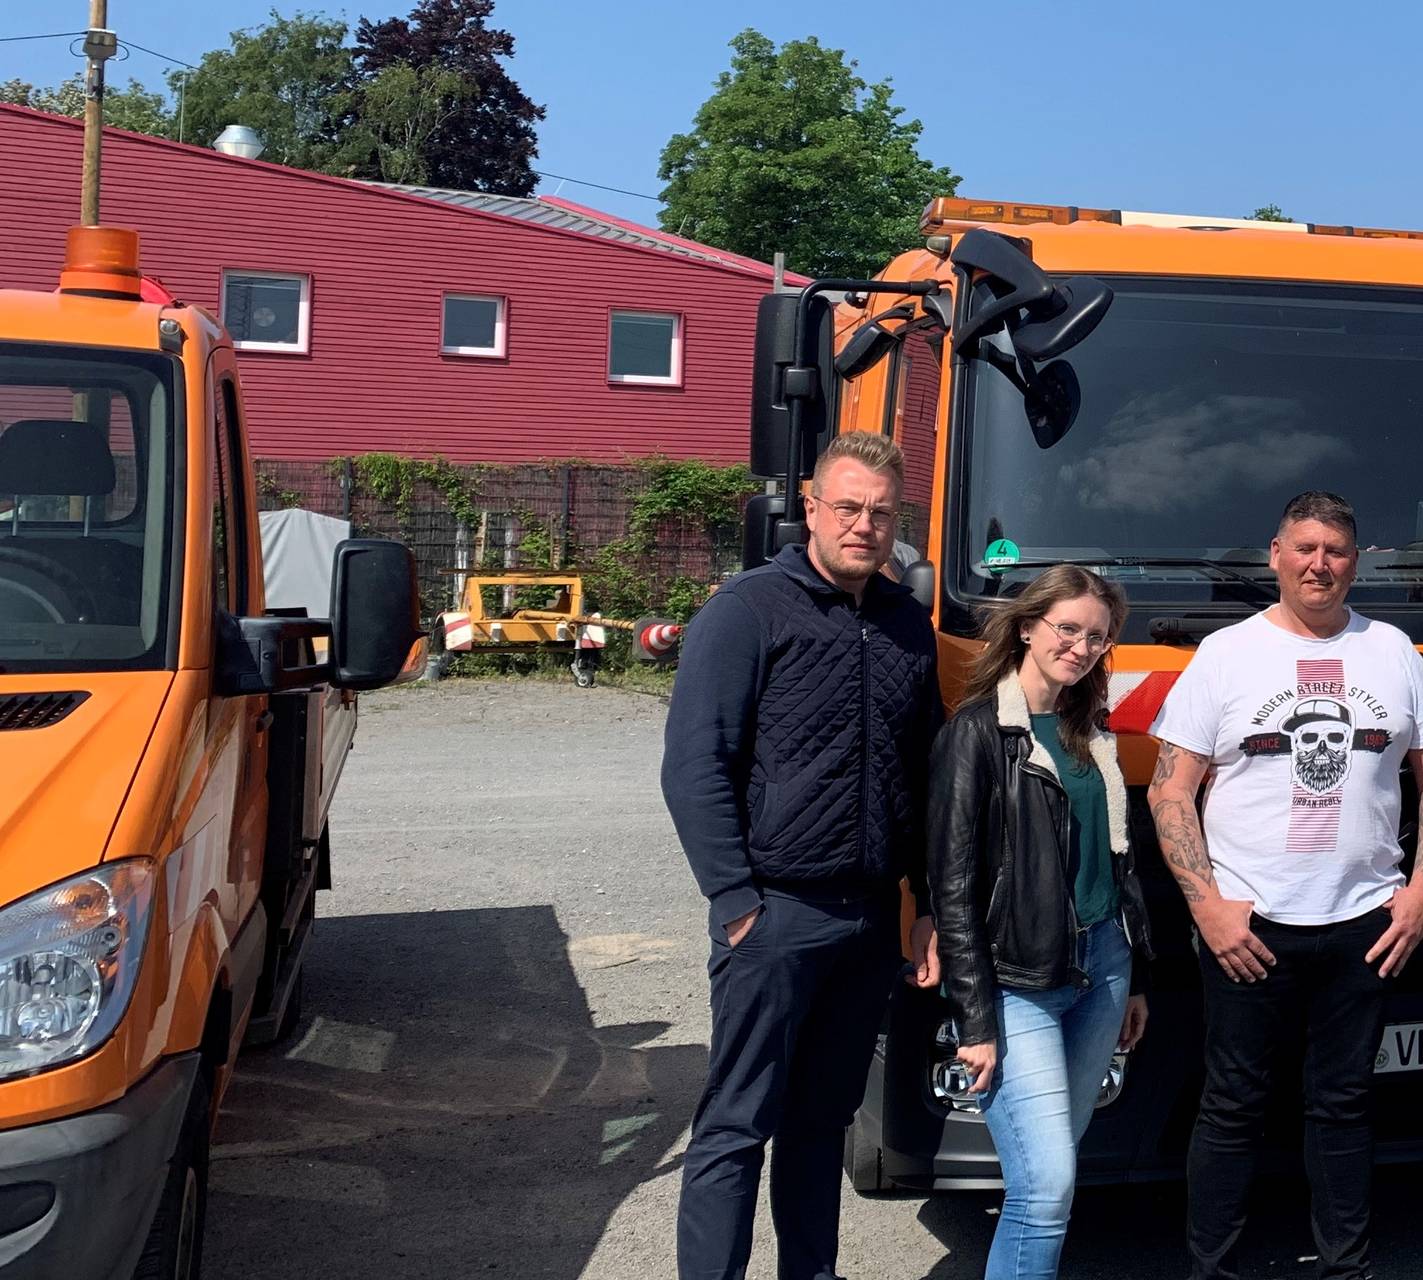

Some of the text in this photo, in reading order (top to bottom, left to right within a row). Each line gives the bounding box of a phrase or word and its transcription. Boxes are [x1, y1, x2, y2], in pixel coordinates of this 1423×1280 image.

[997, 540, 1007, 556] 4
[1251, 682, 1388, 726] MODERN STREET STYLER
[1248, 737, 1280, 752] SINCE
[1292, 796, 1342, 808] URBAN REBEL
